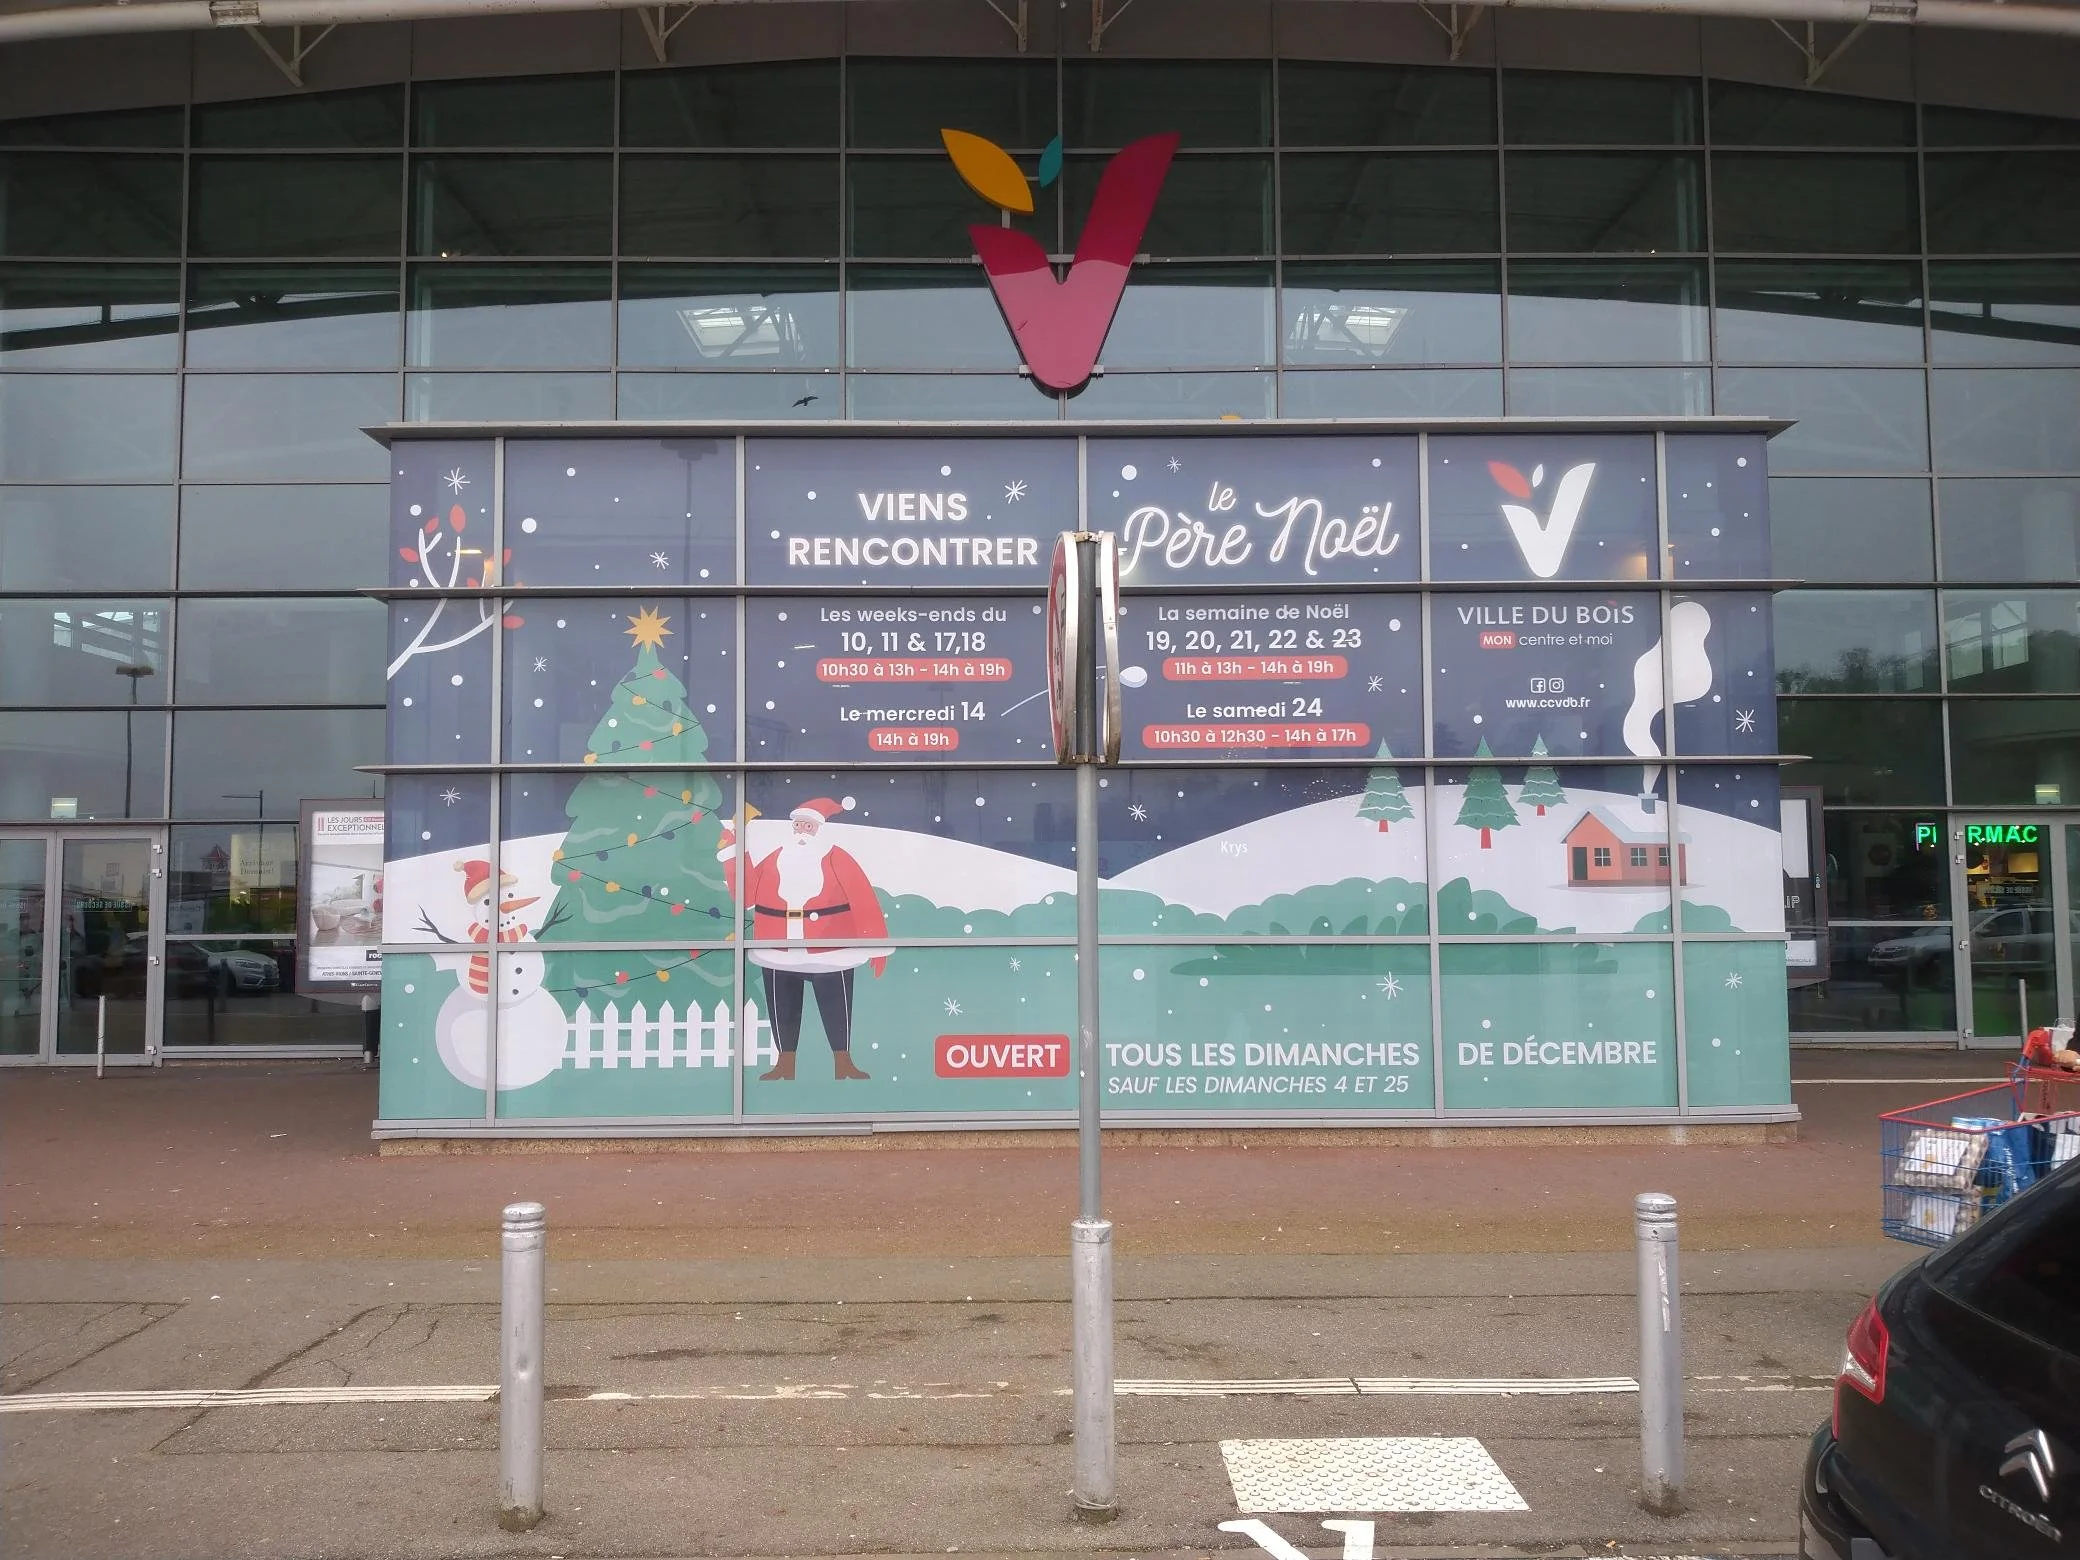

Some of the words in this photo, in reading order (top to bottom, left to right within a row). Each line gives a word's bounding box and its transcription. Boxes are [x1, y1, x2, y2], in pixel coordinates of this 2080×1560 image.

[1208, 481, 1237, 511] le
[858, 493, 968, 521] VIENS
[1119, 506, 1253, 577] Père
[1255, 497, 1400, 576] Noël
[789, 537, 1038, 566] RENCONTRER
[820, 607, 850, 622] Les
[858, 607, 976, 622] weeks-ends
[982, 607, 1007, 622] du
[1158, 606, 1179, 621] La
[1185, 605, 1270, 620] semaine
[1276, 605, 1300, 619] de
[1306, 603, 1349, 619] Noël
[1458, 606, 1524, 624] VILLE
[1532, 606, 1567, 624] DU
[841, 632, 873, 655] 10,
[881, 632, 899, 652] 11
[907, 632, 927, 652] &
[934, 632, 987, 655] 17,18
[1147, 630, 1177, 653] 19,
[1185, 630, 1222, 653] 20,
[1230, 630, 1261, 653] 21,
[1268, 629, 1298, 649] 22
[1306, 629, 1325, 649] &
[1332, 628, 1361, 648] 23
[1483, 635, 1512, 645] MON
[1519, 633, 1565, 646] centre
[1569, 633, 1583, 645] et
[1587, 633, 1613, 645] moi
[821, 663, 869, 677] 10h30
[873, 663, 884, 677] à
[888, 663, 915, 677] 13h
[933, 663, 959, 677] 14h
[964, 663, 975, 677] à
[979, 663, 1005, 676] 19h
[1174, 662, 1196, 675] 11h
[1201, 661, 1212, 674] à
[1216, 661, 1242, 675] 13h
[1261, 661, 1287, 674] 14h
[1292, 660, 1302, 674] à
[1308, 660, 1334, 673] 19h
[840, 707, 861, 721] Le
[867, 706, 955, 721] mercredi
[961, 701, 985, 721] 14
[1187, 703, 1208, 719] Le
[1213, 702, 1286, 718] samedi
[1292, 697, 1323, 717] 24
[1505, 696, 1590, 708] www.ccvdb.fr
[877, 732, 903, 746] 14h
[908, 732, 920, 746] à
[924, 732, 949, 746] 19h
[1154, 730, 1200, 743] 10h30
[1205, 729, 1216, 743] à
[1220, 729, 1266, 743] 12h30
[1285, 728, 1311, 742] 14h
[1316, 728, 1327, 741] à
[1332, 728, 1356, 741] 17h
[1220, 840, 1248, 857] Krys
[946, 1044, 1061, 1069] OUVERT
[1106, 1043, 1182, 1066] TOUS
[1192, 1043, 1236, 1066] LES
[1245, 1043, 1420, 1066] DIMANCHES
[1458, 1042, 1494, 1066] DE
[1503, 1035, 1657, 1065] DÉCEMBRE
[1108, 1076, 1160, 1094] SAUF
[1165, 1076, 1198, 1094] LES
[1204, 1076, 1327, 1094] DIMANCHES
[1334, 1076, 1348, 1093] 4
[1355, 1076, 1378, 1093] ET
[1384, 1075, 1409, 1093] 25
